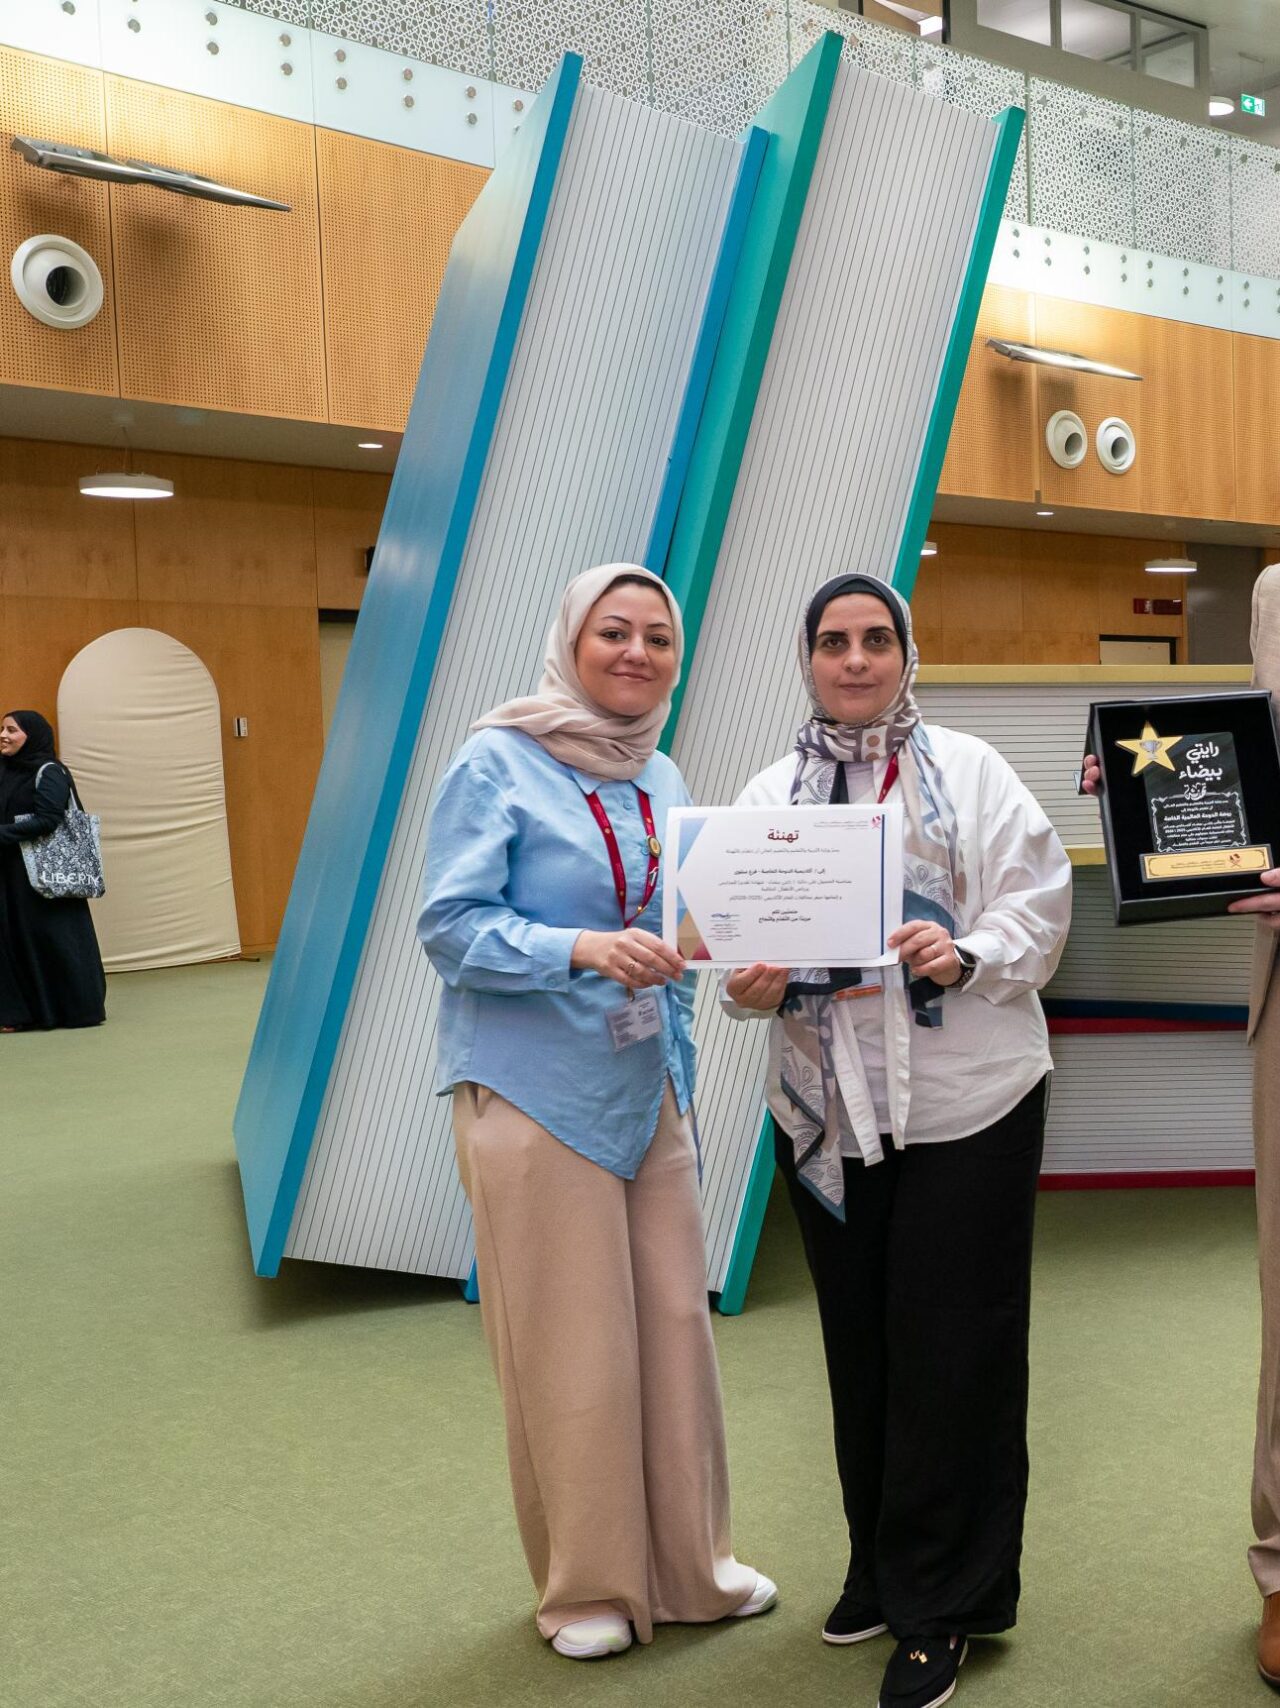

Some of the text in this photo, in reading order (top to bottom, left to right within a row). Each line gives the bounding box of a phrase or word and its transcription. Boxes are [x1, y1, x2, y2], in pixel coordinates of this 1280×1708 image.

[1185, 741, 1220, 764] رايتي
[1178, 764, 1223, 781] بيضاء
[767, 828, 800, 843] تهنئة
[41, 870, 100, 886] LIBERTY
